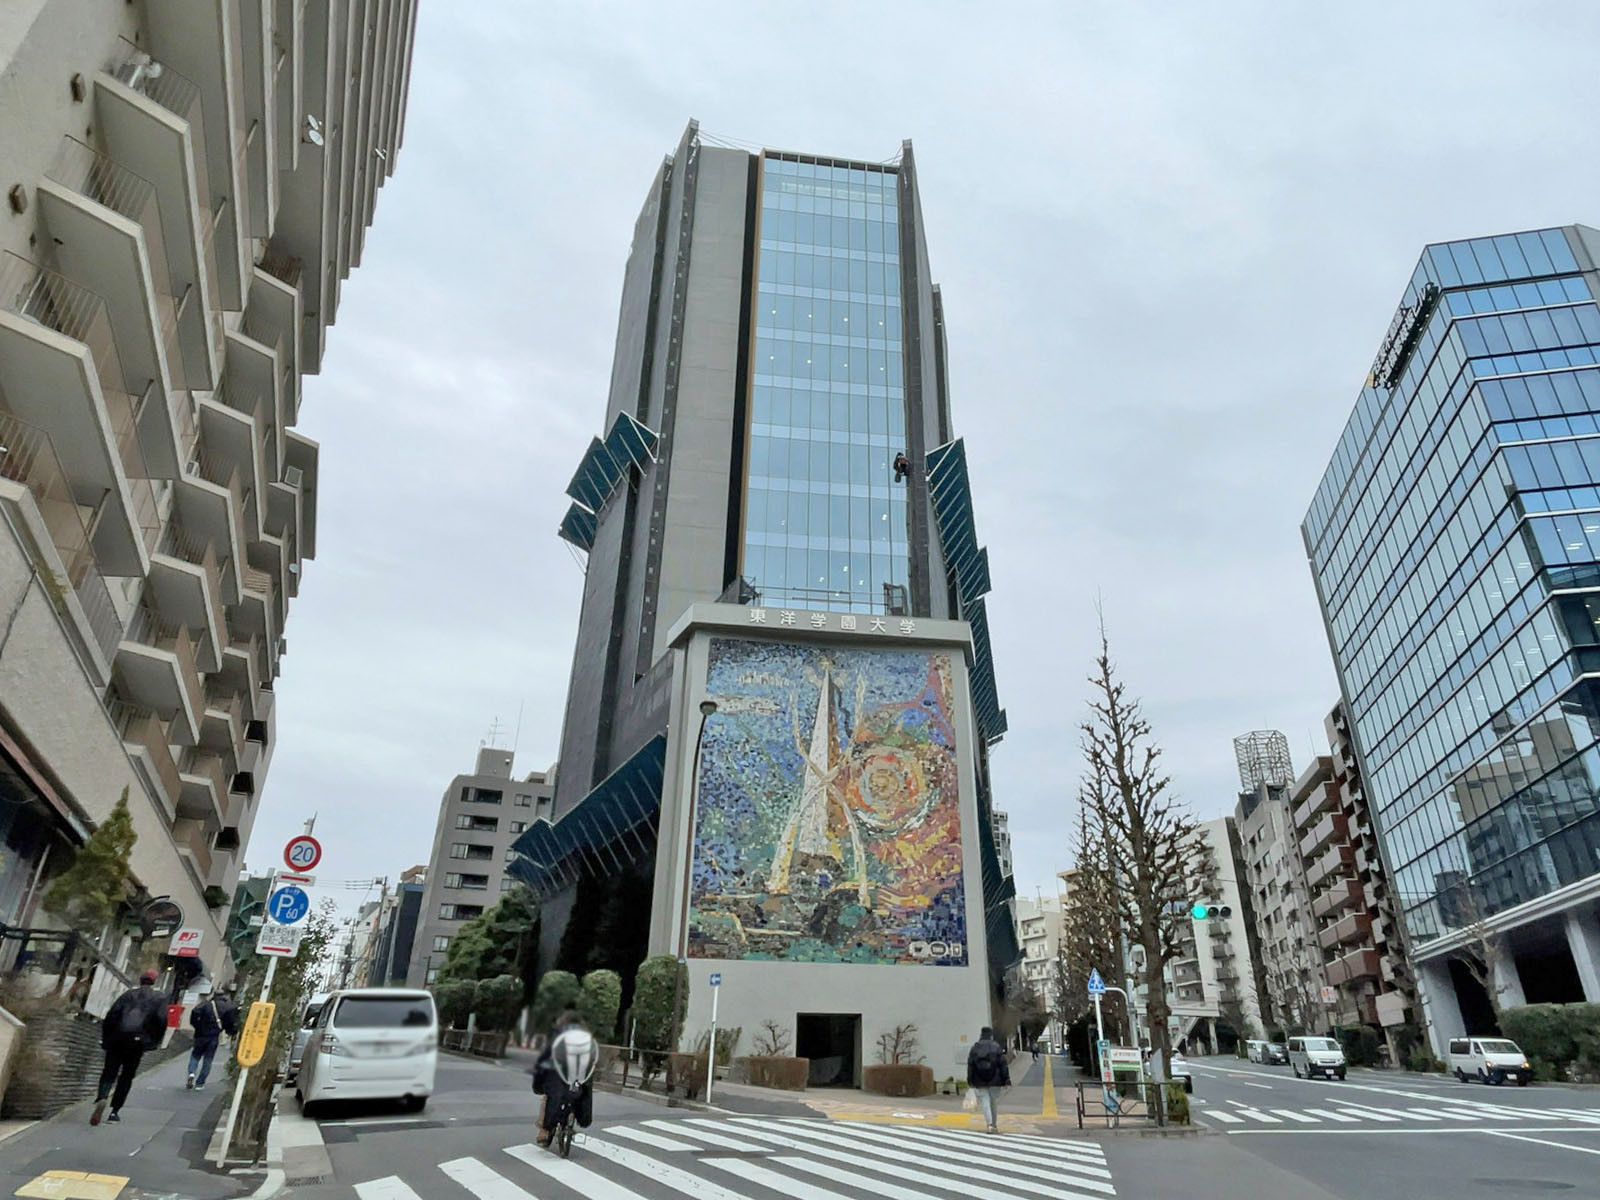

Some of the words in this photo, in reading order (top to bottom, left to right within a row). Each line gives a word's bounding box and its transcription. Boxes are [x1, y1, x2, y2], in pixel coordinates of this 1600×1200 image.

[750, 609, 916, 634] 東洋学園大学
[291, 845, 314, 863] 20
[275, 893, 295, 918] P
[285, 908, 299, 919] 60
